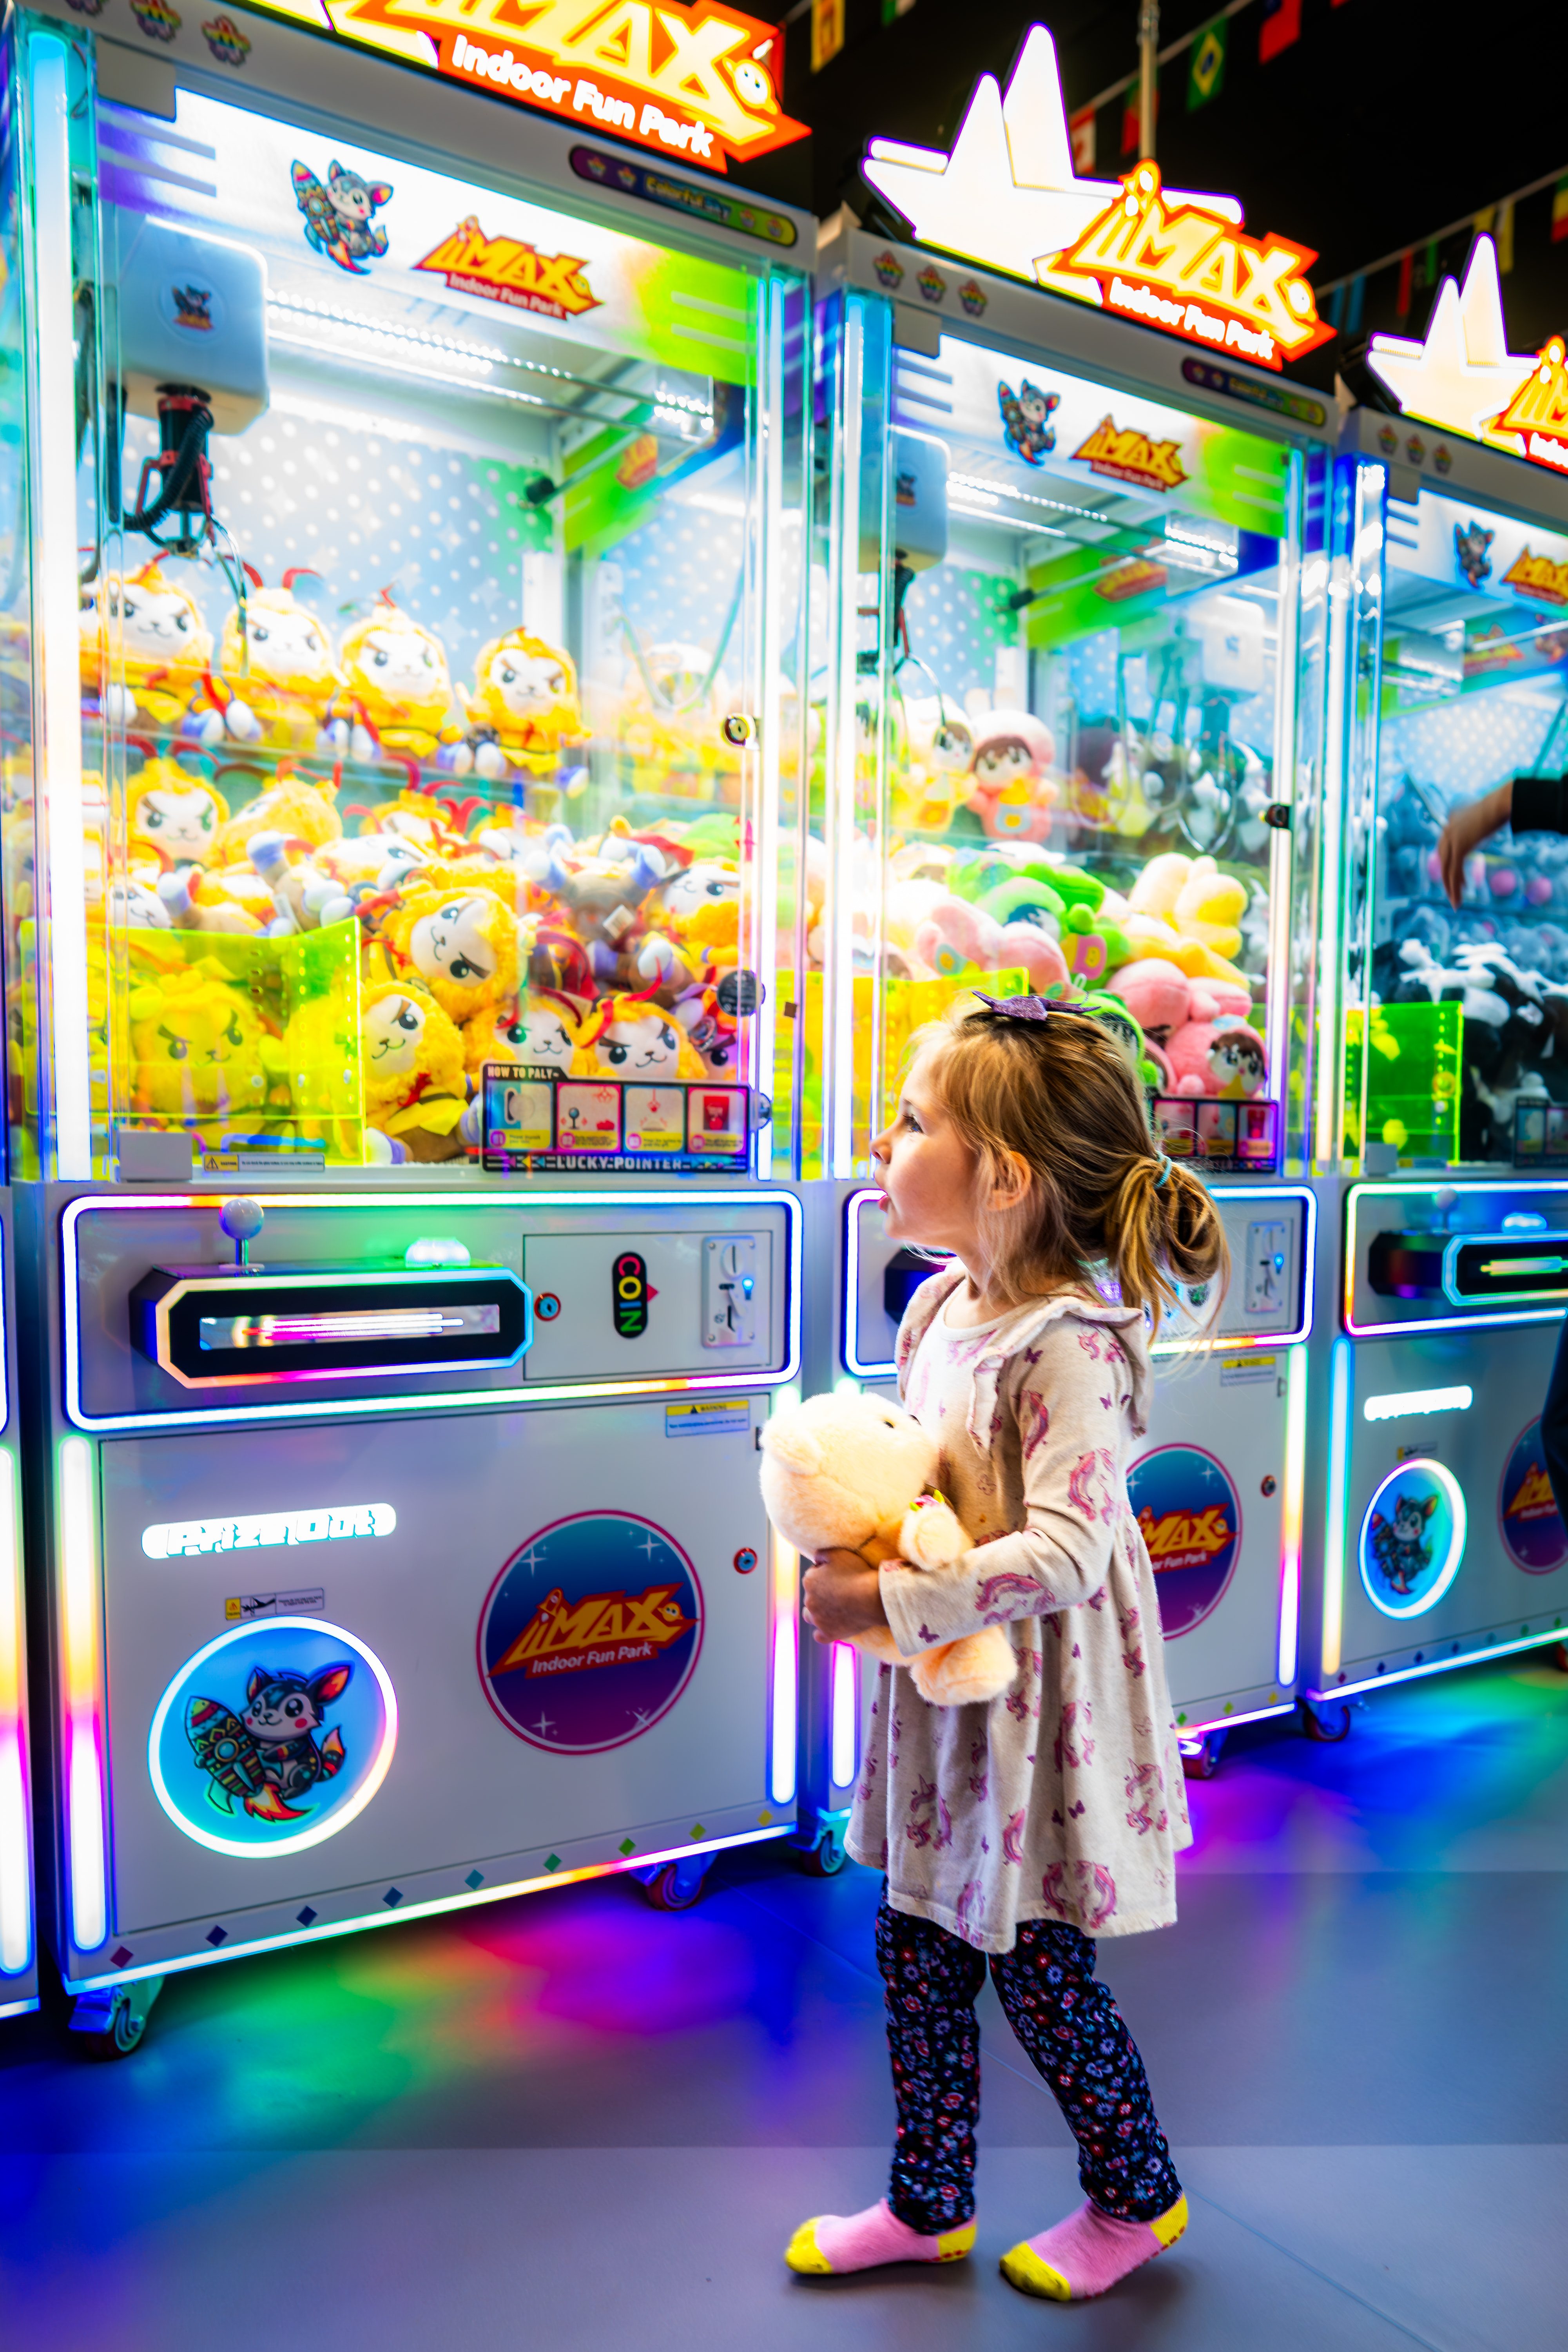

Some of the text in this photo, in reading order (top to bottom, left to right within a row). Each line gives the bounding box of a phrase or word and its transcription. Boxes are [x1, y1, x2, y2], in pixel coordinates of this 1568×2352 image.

[451, 34, 713, 158] Indoor Fun Park
[450, 273, 563, 317] Indoor Fun Park
[1109, 276, 1274, 360] Indoor Fun Park
[488, 1066, 509, 1077] HOW
[513, 1067, 526, 1078] TO
[618, 1256, 643, 1332] COIN
[1163, 1556, 1185, 1569] Fun
[1185, 1551, 1208, 1565] Park
[532, 1641, 653, 1674] Indoor Fun Park
